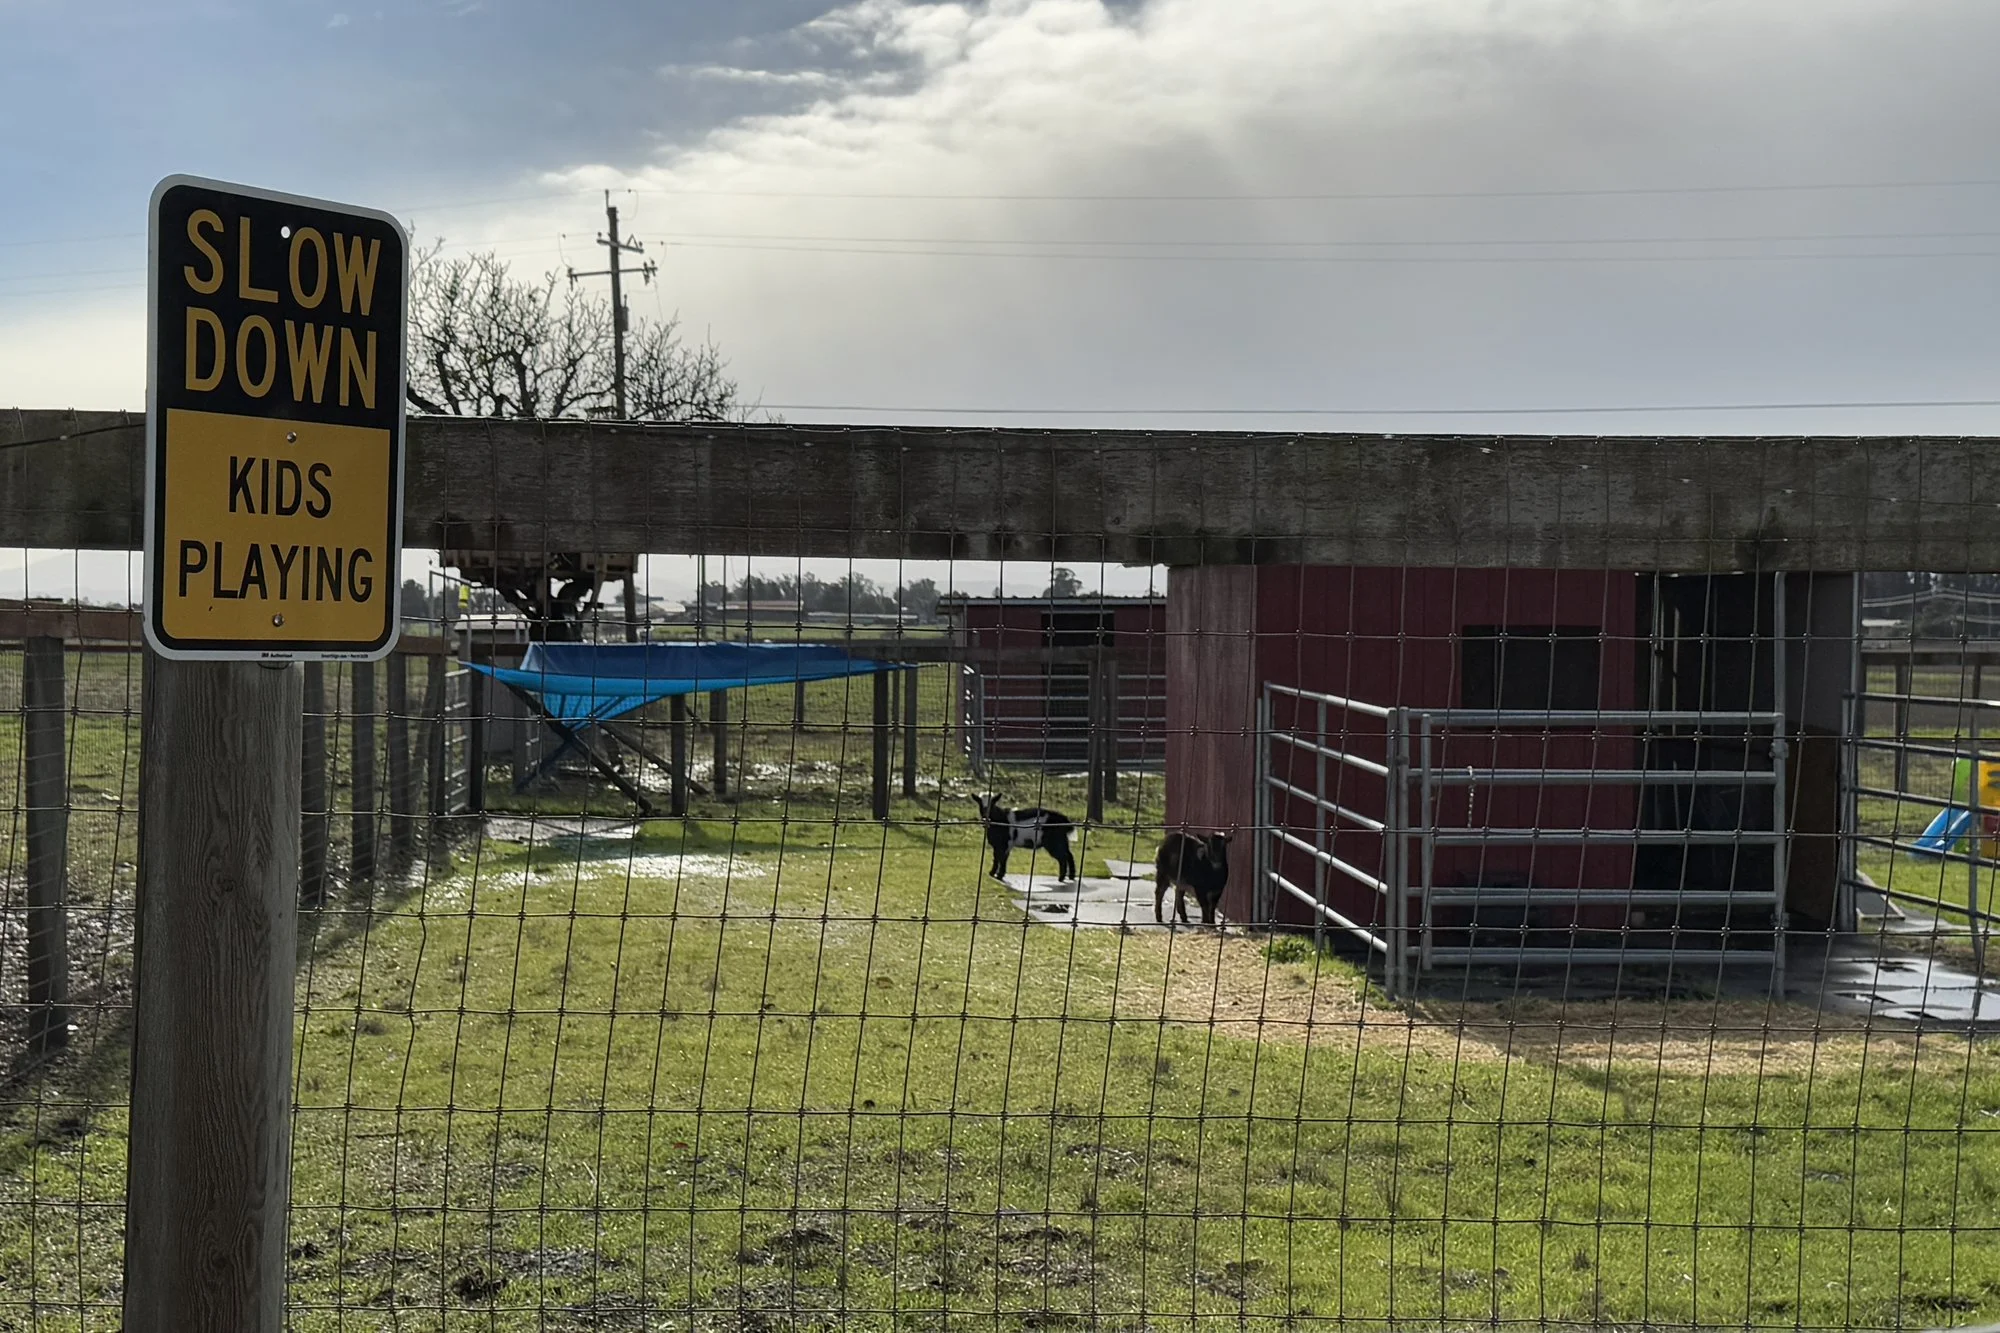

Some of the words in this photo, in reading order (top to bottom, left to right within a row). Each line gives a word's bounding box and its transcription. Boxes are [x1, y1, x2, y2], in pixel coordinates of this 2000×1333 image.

[184, 208, 381, 316] SLOW
[185, 306, 377, 409] DOWN
[228, 455, 333, 519] KIDS
[178, 539, 374, 603] PLAYING
